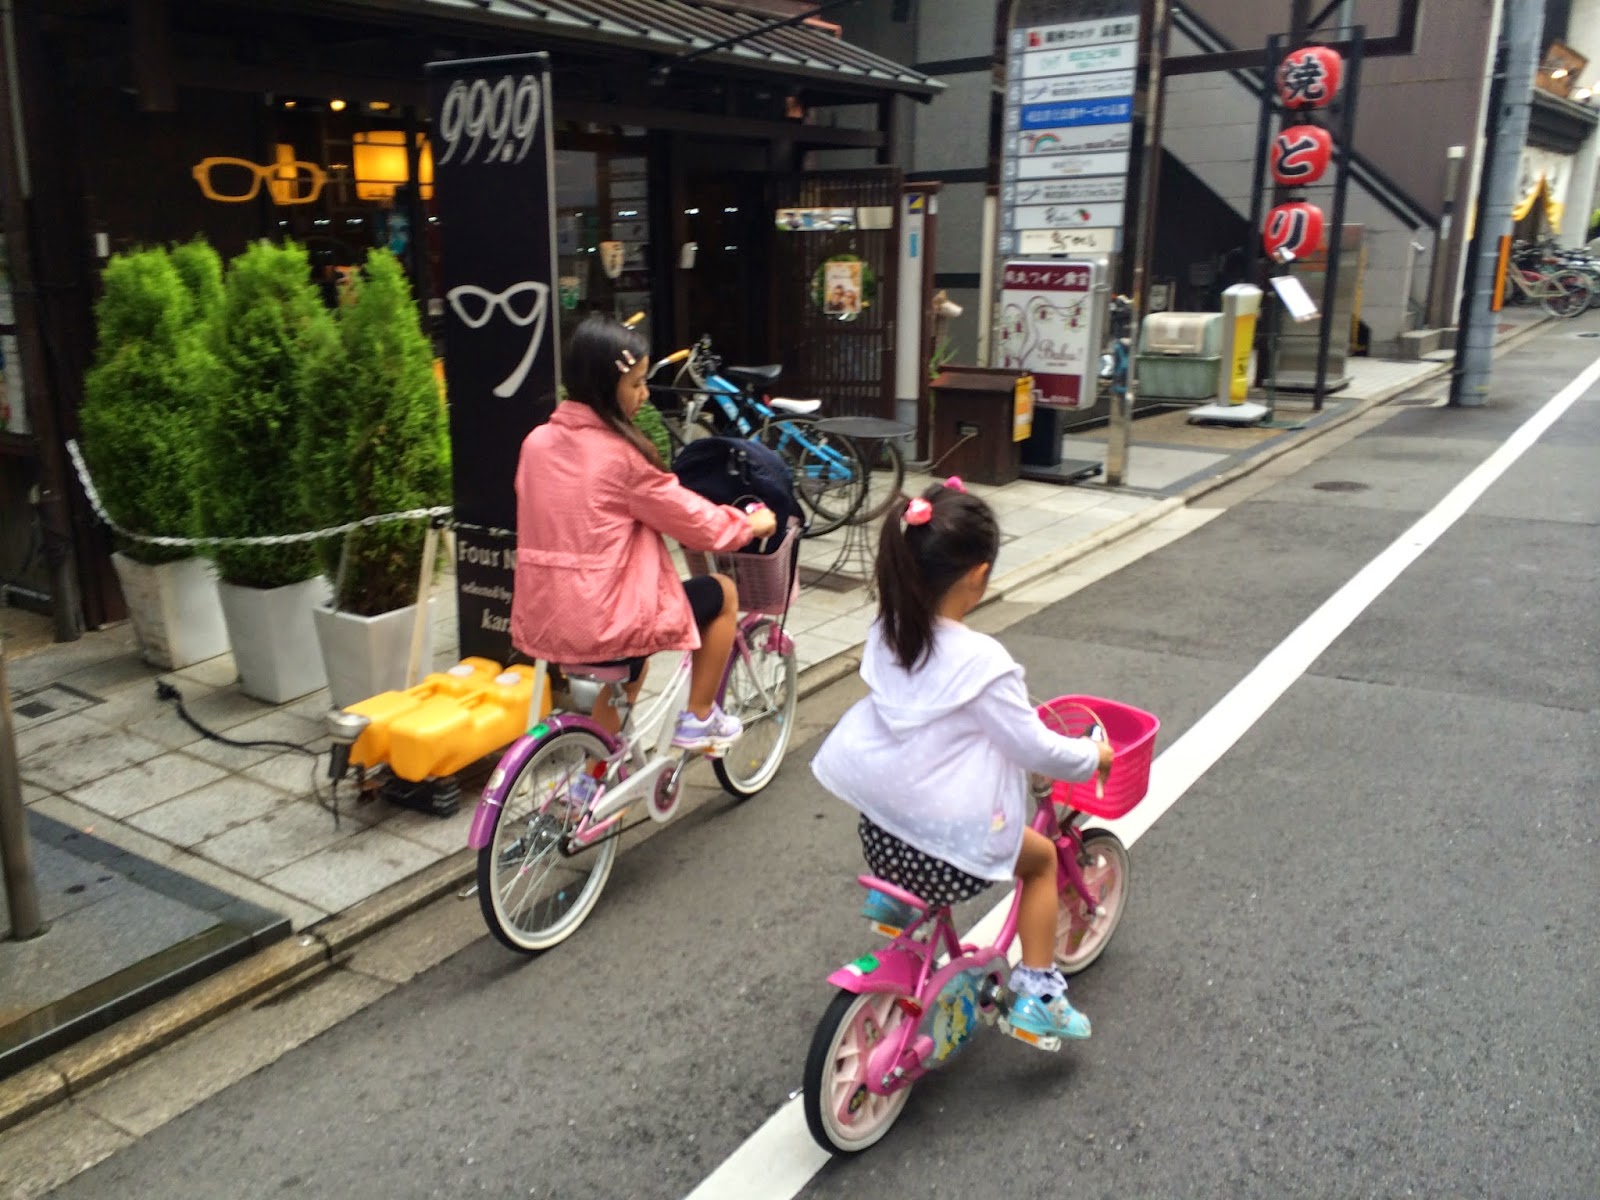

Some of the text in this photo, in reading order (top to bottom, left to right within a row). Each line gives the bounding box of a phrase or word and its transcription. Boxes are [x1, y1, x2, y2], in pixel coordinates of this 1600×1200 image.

[437, 74, 541, 165] 999.9
[1269, 54, 1328, 252] 焼とり
[458, 540, 500, 568] Four
